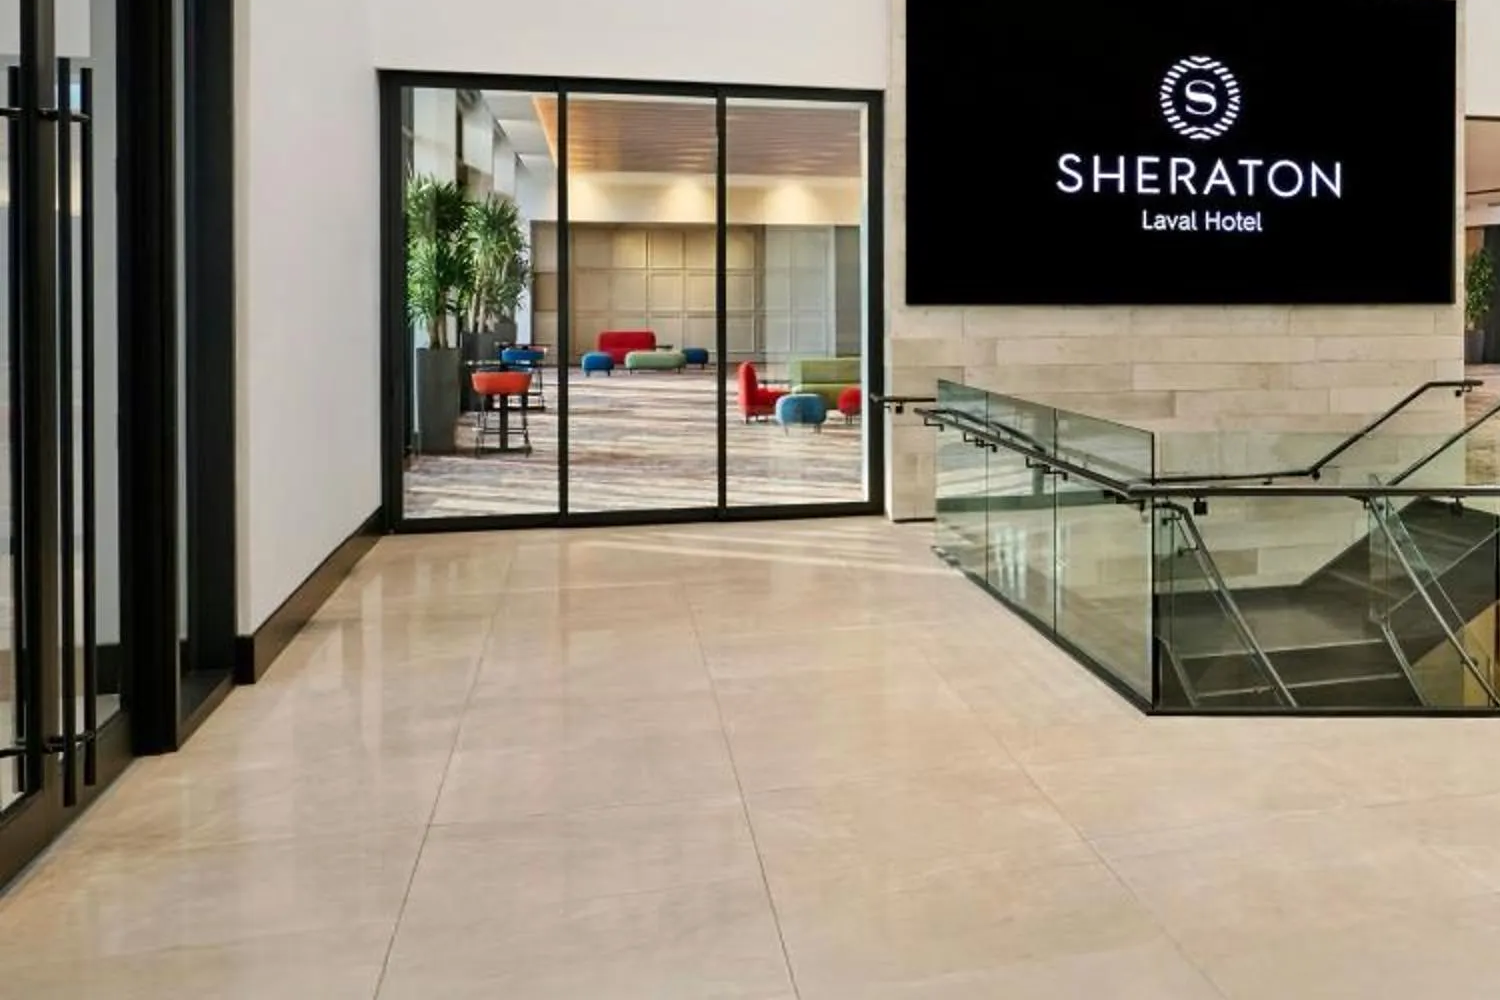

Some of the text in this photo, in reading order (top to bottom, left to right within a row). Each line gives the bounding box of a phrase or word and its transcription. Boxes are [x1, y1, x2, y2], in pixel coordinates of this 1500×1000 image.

[1184, 79, 1218, 116] S
[1055, 152, 1342, 199] SHERATON
[1141, 209, 1263, 232] Laval Hotel
